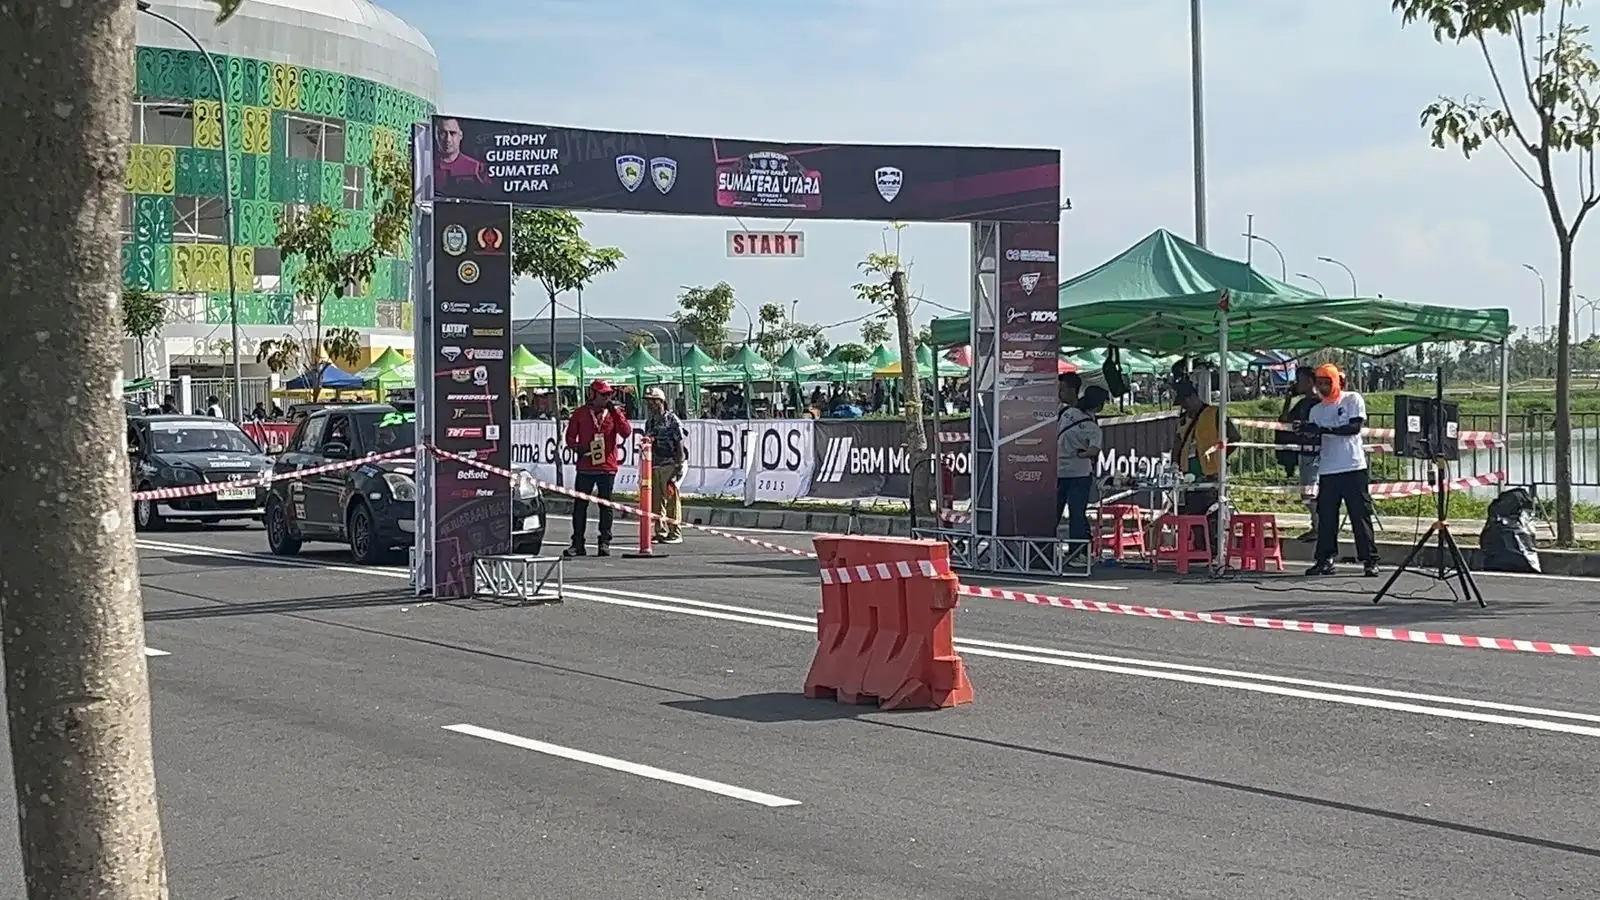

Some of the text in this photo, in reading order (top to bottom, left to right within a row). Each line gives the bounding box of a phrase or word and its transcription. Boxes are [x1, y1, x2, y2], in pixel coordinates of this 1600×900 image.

[494, 133, 547, 147] TROPHY
[486, 149, 559, 162] GUBERNUR
[488, 164, 560, 177] SUMATERA
[503, 179, 549, 192] UTARA
[718, 172, 820, 194] SUMATERA UTARA
[733, 233, 799, 254] START
[850, 446, 885, 474] BRM
[758, 479, 785, 491] 2015
